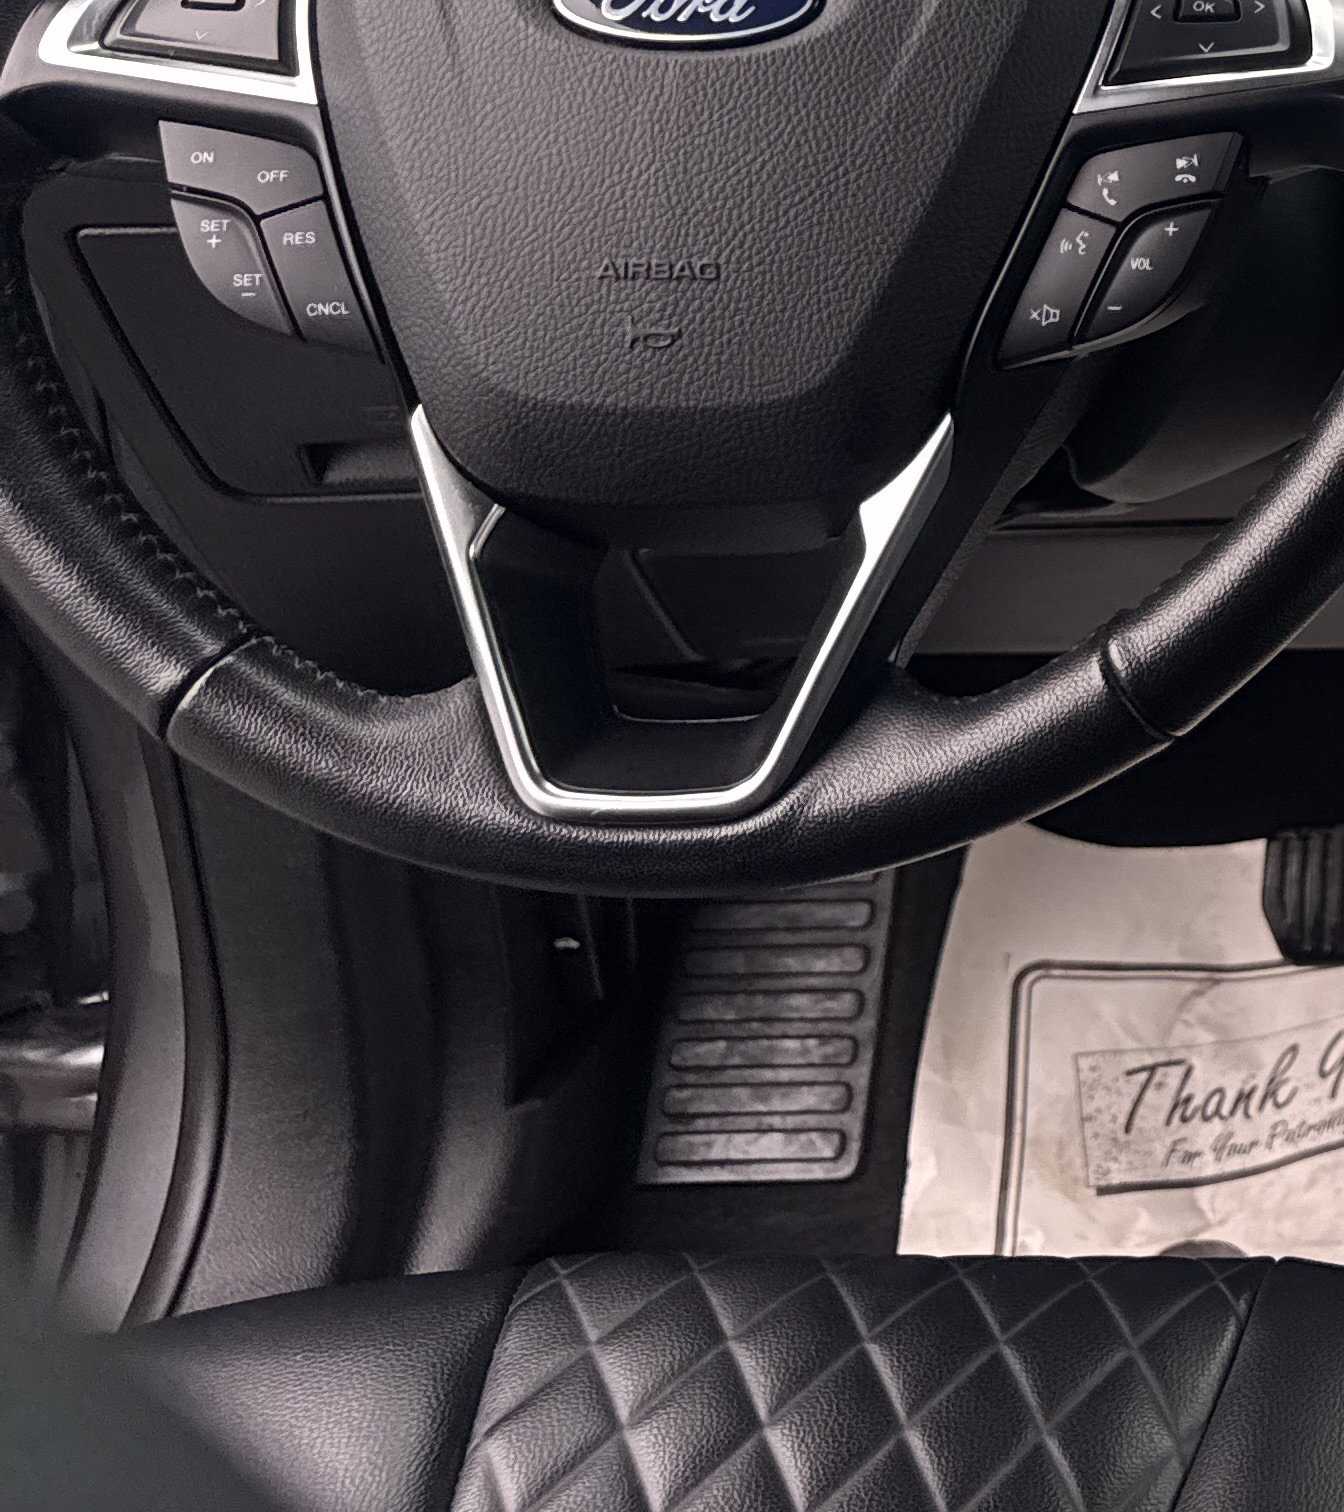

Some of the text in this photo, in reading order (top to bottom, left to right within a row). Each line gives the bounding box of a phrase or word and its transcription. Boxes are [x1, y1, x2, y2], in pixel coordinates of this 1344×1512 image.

[1193, 0, 1216, 14] OK
[191, 152, 214, 164] ON
[257, 170, 289, 183] OFF
[200, 219, 230, 232] SET
[282, 232, 316, 245] RES
[598, 257, 721, 281] AIRBAG
[1130, 257, 1153, 271] VOL
[233, 273, 263, 287] SET
[306, 303, 351, 317] CNCL
[1124, 1043, 1300, 1134] Thank
[1161, 1138, 1204, 1168] For
[1211, 1133, 1262, 1164] Your
